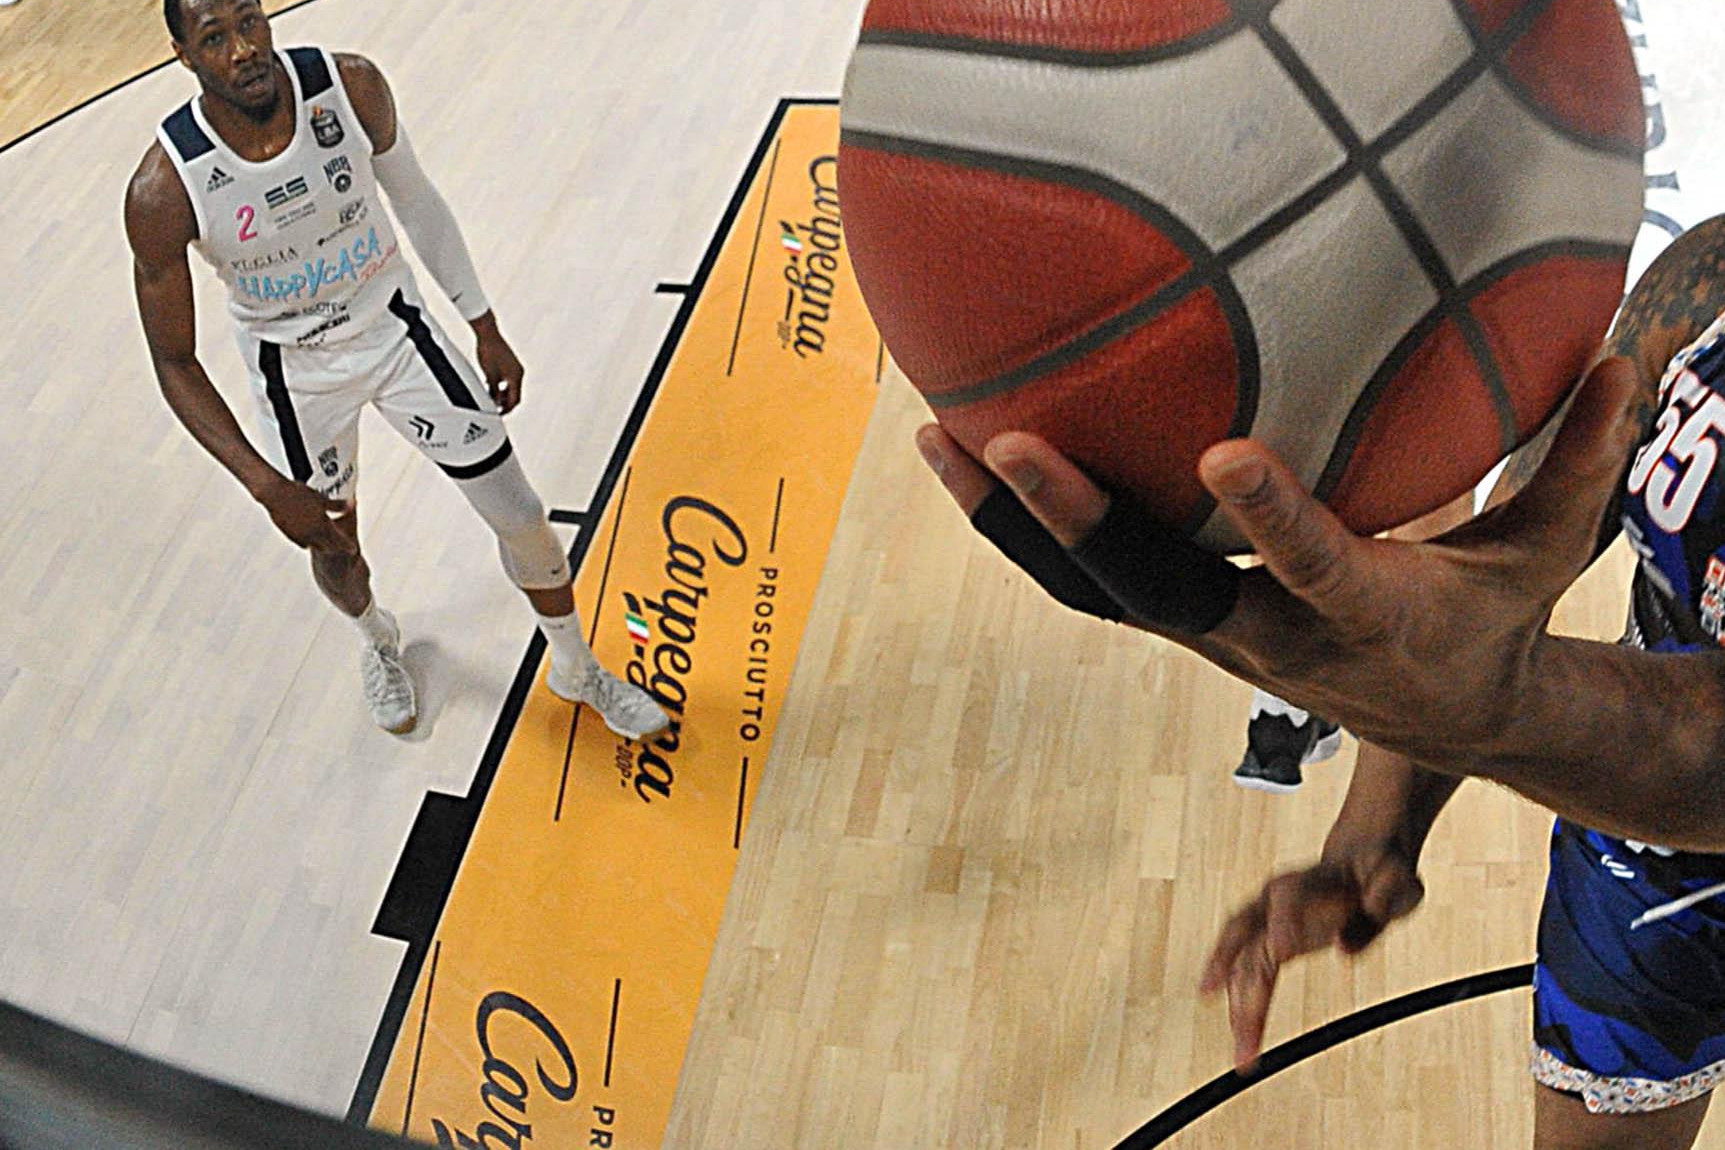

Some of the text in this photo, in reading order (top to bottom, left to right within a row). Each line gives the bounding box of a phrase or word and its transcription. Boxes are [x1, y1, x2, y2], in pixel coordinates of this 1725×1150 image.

[234, 204, 258, 243] 2
[626, 494, 749, 805] Carpegna
[739, 566, 778, 742] PROSCIUTTO
[589, 1104, 617, 1150] PR
